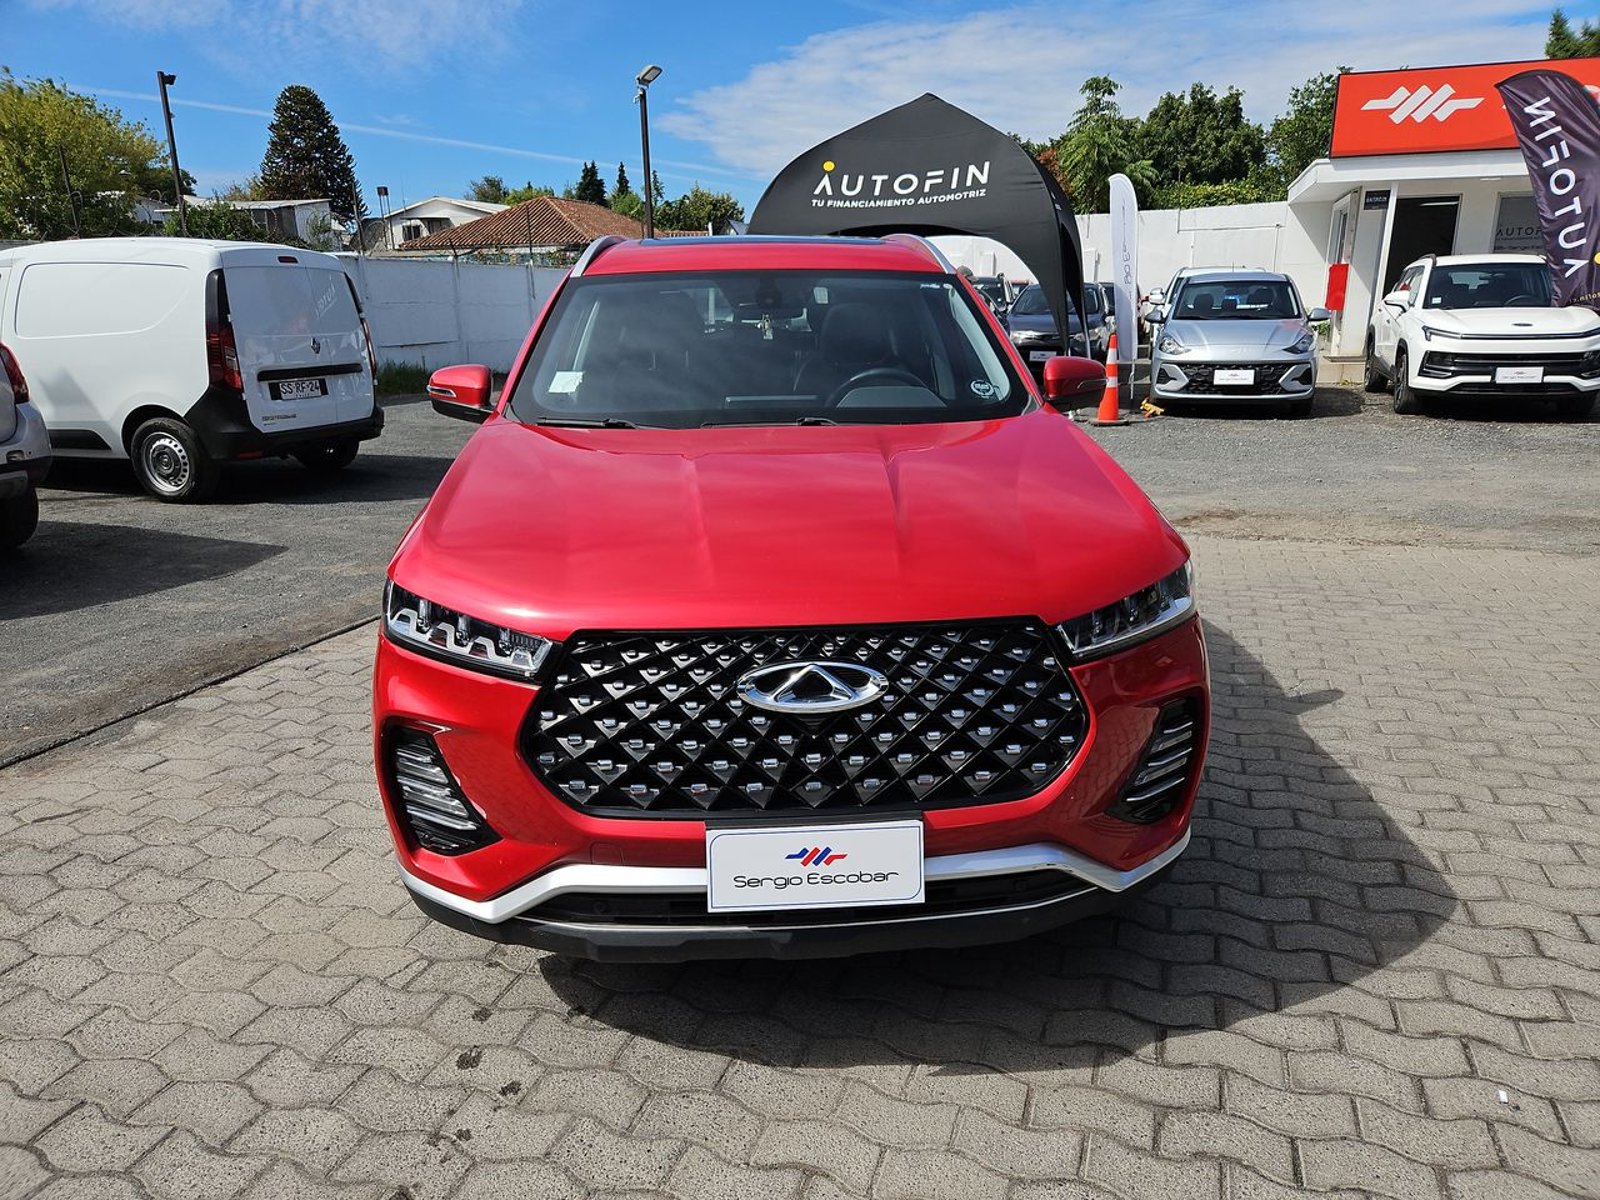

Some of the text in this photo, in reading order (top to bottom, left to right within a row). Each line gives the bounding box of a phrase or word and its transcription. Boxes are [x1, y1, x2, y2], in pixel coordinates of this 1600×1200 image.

[813, 160, 991, 197] AUTOFIN
[811, 188, 987, 209] TU FINANCIAMIENTO AUTOMOTRIZ
[1496, 225, 1543, 237] AUTOF
[733, 870, 900, 890] Sergio Escobar
